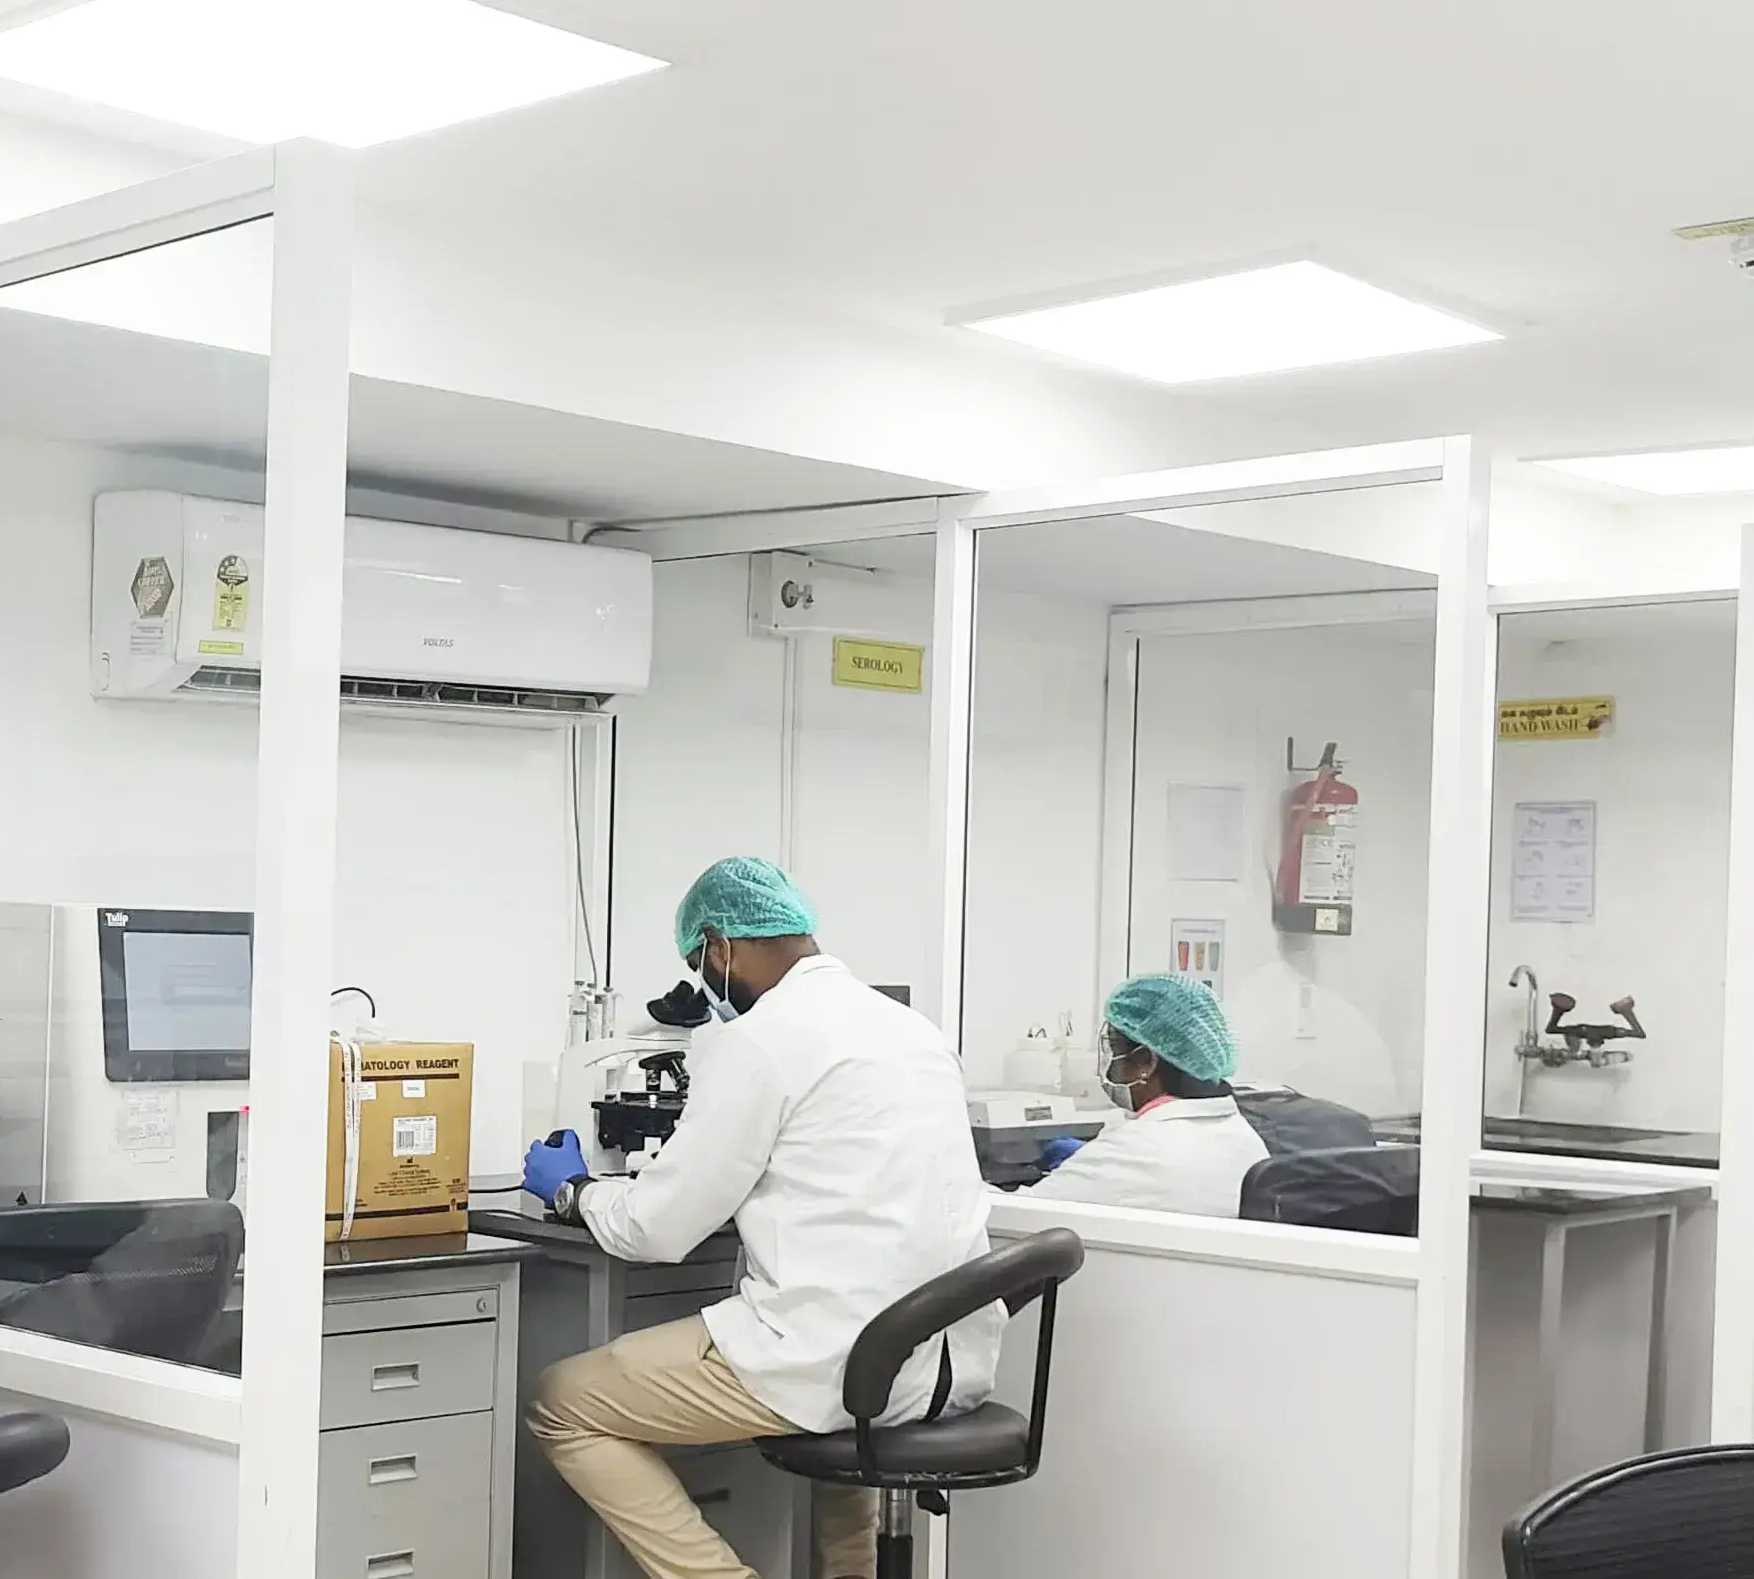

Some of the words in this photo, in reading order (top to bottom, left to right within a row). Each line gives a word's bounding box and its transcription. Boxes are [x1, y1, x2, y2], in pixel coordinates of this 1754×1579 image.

[852, 656, 903, 674] SEROLOGY
[1539, 719, 1578, 732] WASH
[416, 1059, 459, 1069] REAGENT
